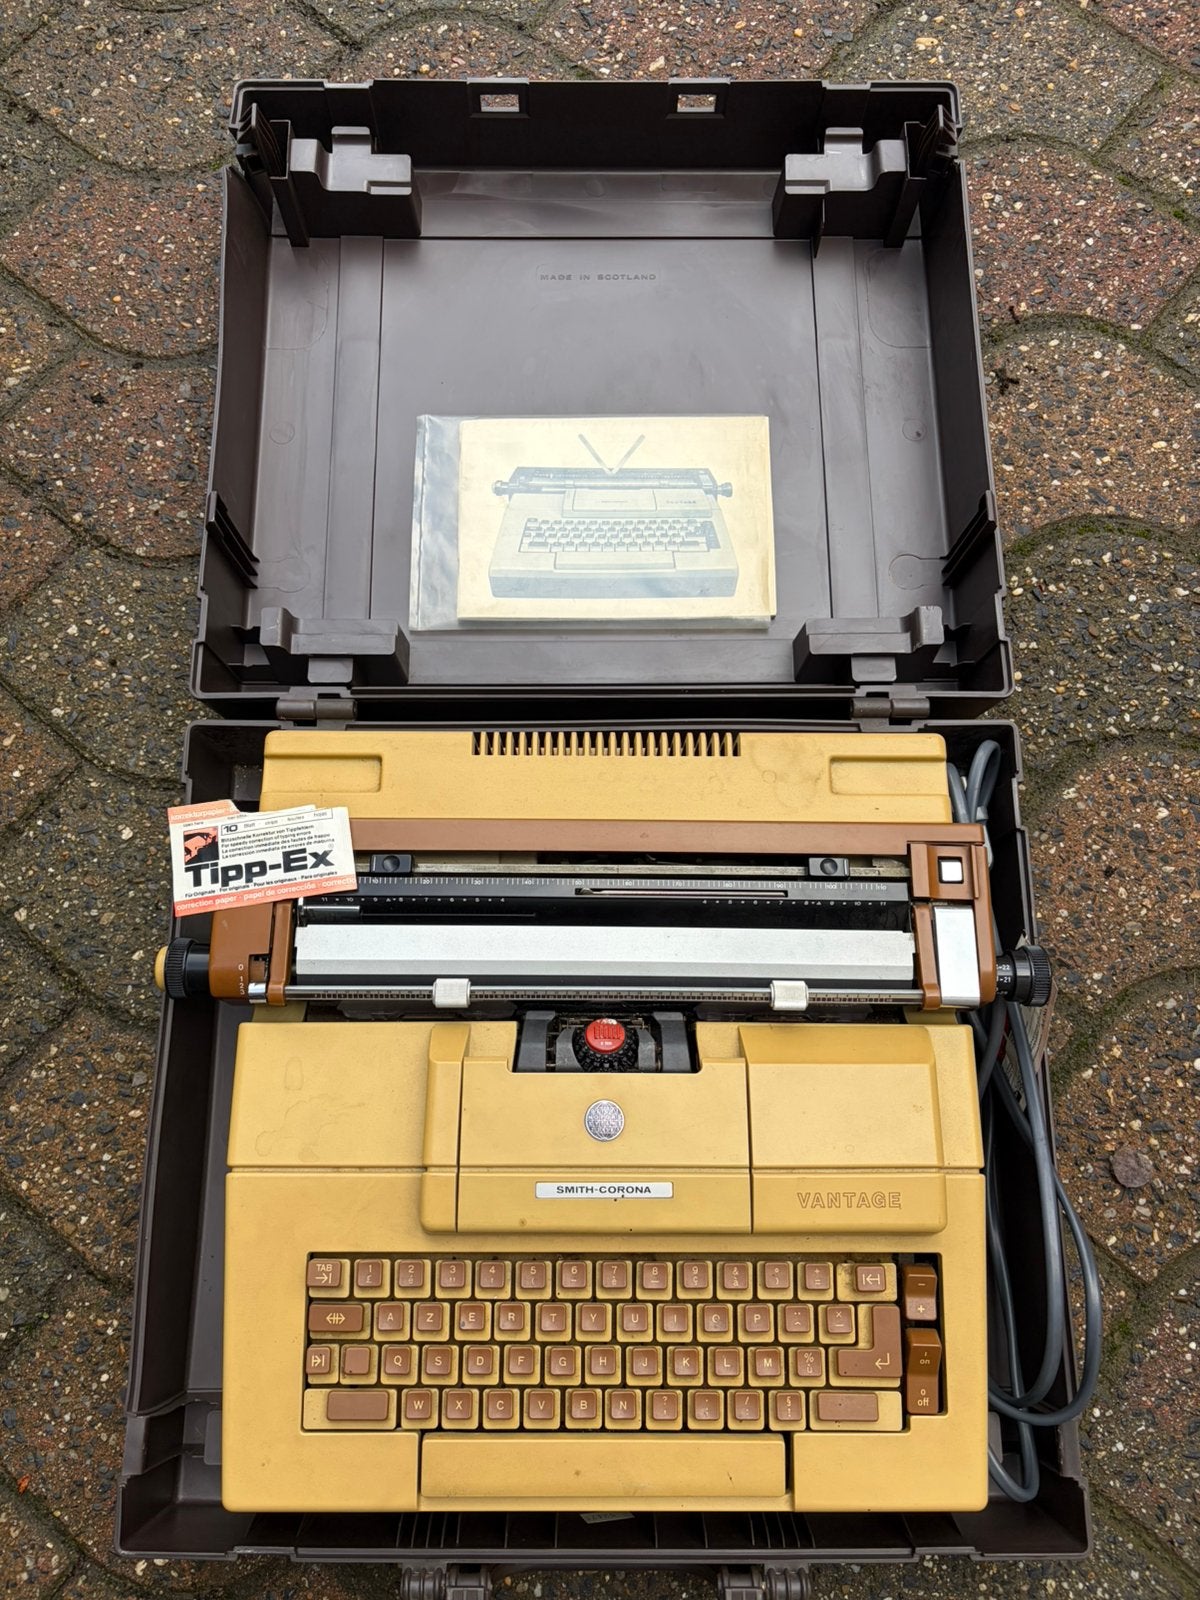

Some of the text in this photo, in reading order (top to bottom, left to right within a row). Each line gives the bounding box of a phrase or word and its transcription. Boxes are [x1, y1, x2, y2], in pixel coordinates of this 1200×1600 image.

[184, 848, 334, 888] Tipp-Ex
[176, 898, 213, 910] correction
[215, 896, 237, 905] paper
[243, 890, 264, 901] papel
[556, 1185, 652, 1195] SMITH-CORONA
[797, 1192, 901, 1208] VANTAGE
[368, 1264, 372, 1272] 1
[408, 1265, 415, 1273] 2
[449, 1265, 456, 1274] 3
[489, 1266, 496, 1274] 4
[530, 1266, 536, 1274] 5
[571, 1266, 577, 1274] 6
[612, 1266, 617, 1274] 7
[652, 1267, 658, 1275] 8
[692, 1266, 698, 1274] 9
[387, 1313, 393, 1321] A
[426, 1313, 433, 1322] Z
[469, 1313, 475, 1322] E
[508, 1313, 515, 1322] R
[550, 1314, 557, 1322] T
[590, 1314, 597, 1322] Y
[632, 1314, 638, 1323] U
[754, 1314, 761, 1323] P
[394, 1352, 814, 1367] Q S D F G H J K L M %
[414, 1401, 424, 1410] W
[456, 1401, 463, 1410] X
[496, 1401, 504, 1410] C
[538, 1401, 545, 1410] V
[580, 1401, 587, 1410] B
[620, 1402, 627, 1411] N
[918, 1398, 929, 1406] off
